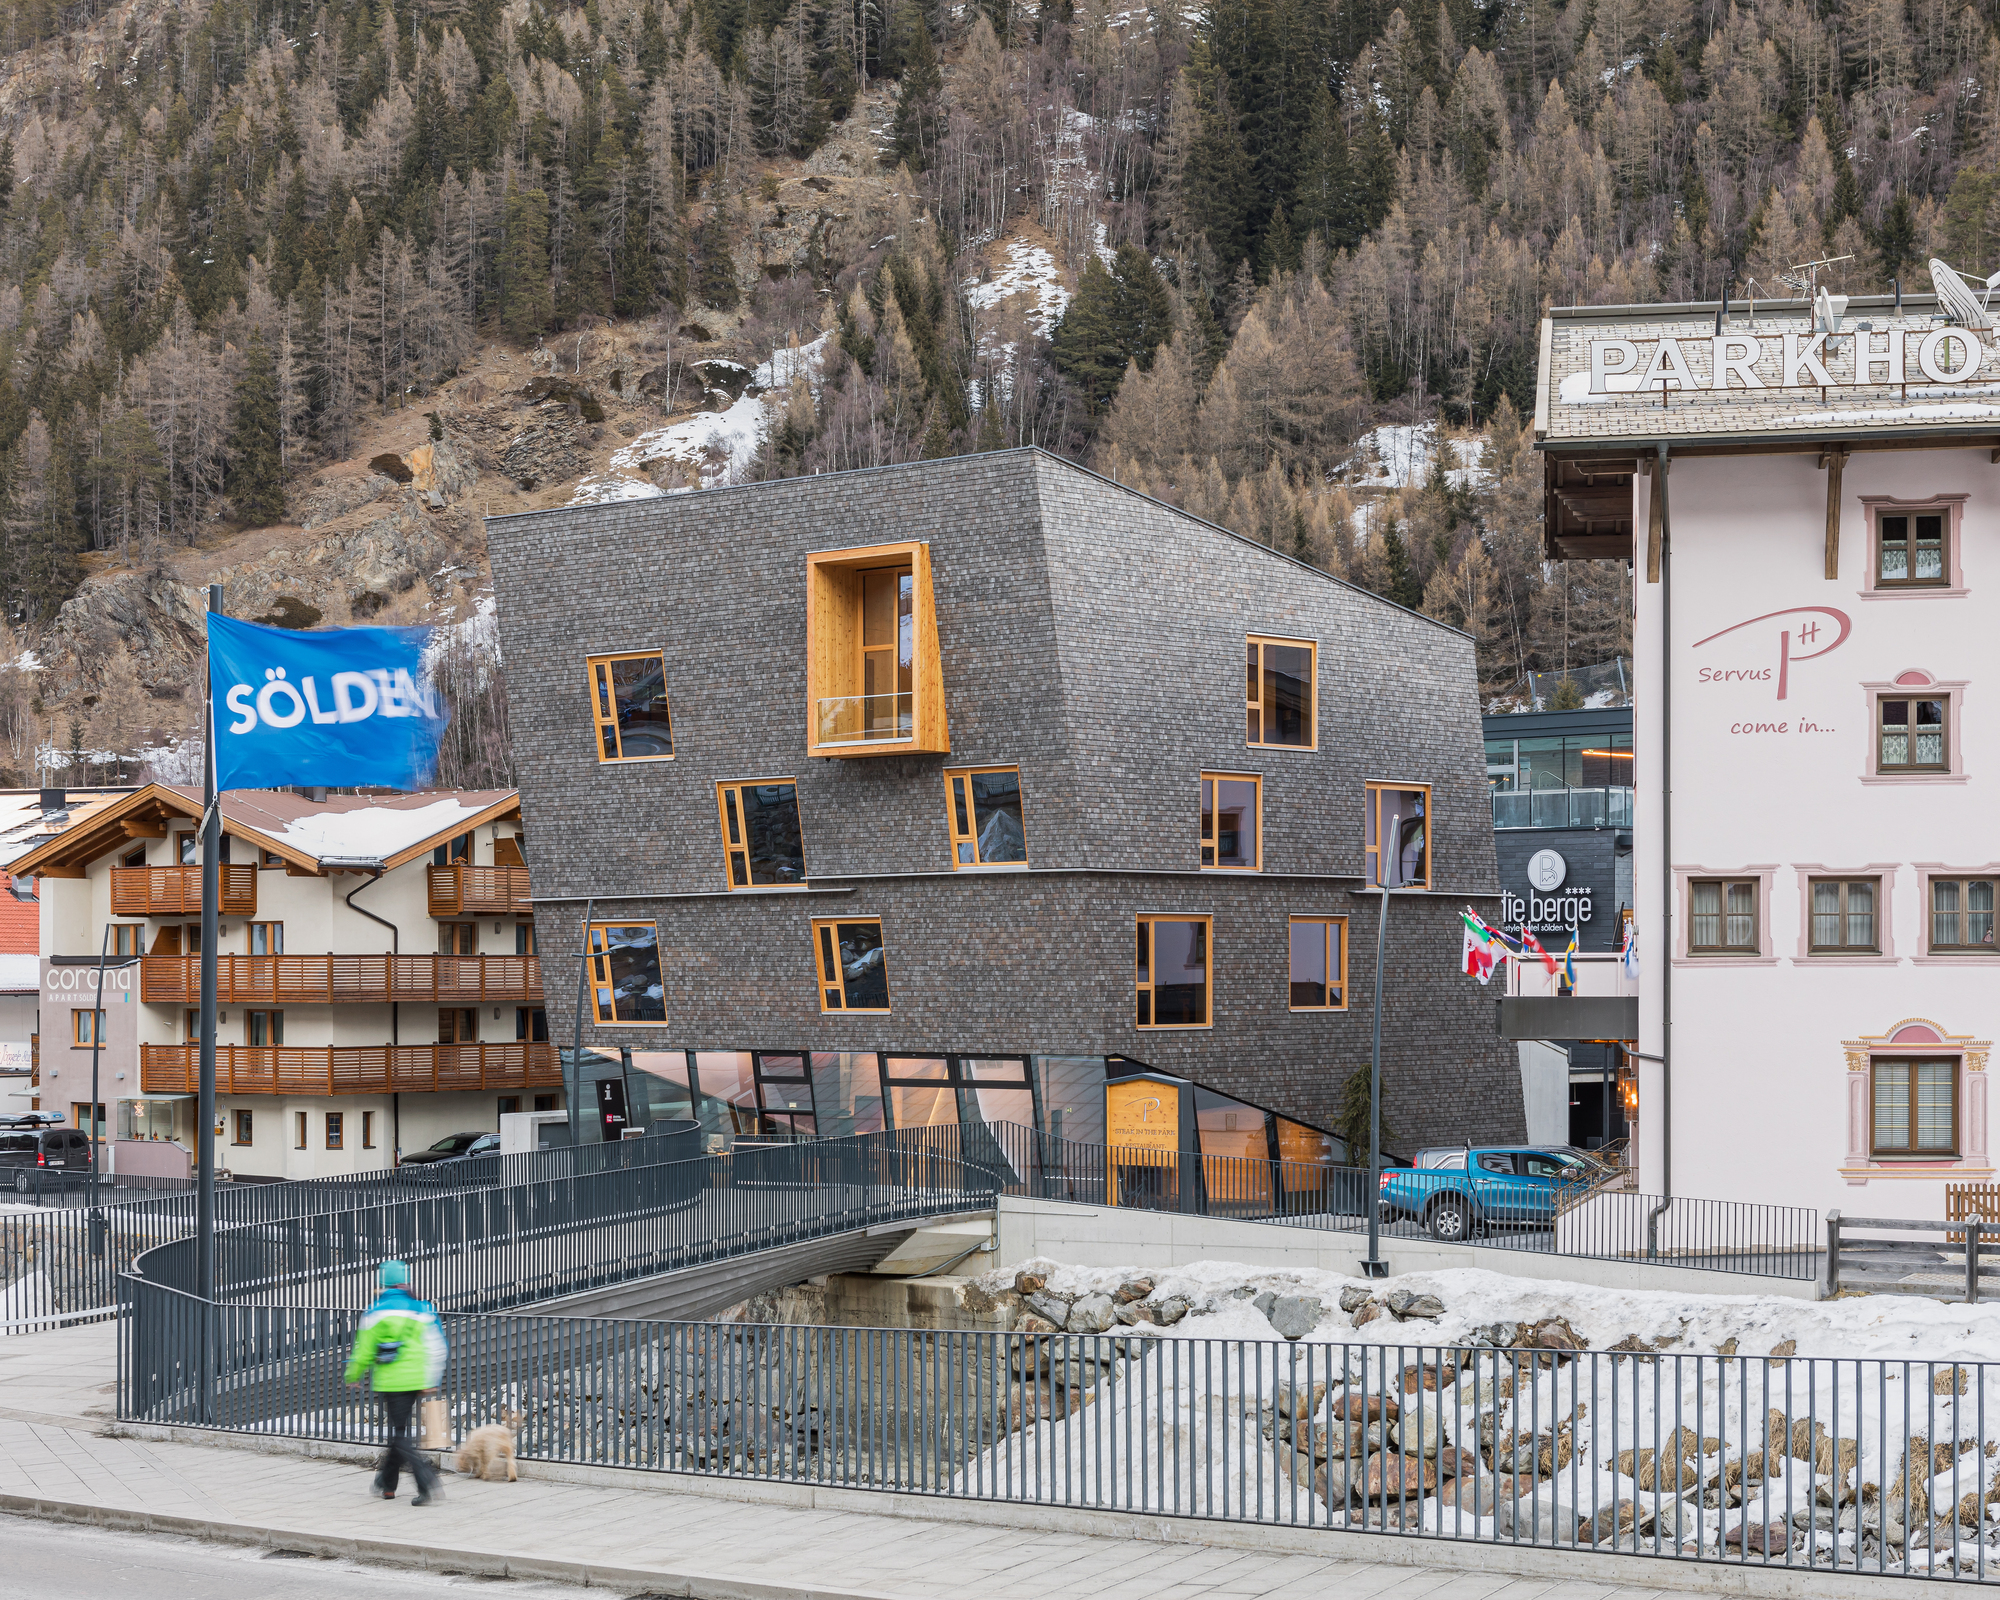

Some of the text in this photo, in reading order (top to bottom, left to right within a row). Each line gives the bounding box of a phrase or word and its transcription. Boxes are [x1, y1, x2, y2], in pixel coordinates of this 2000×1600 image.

[1588, 326, 2000, 394] PARKHO
[1699, 667, 1772, 683] Servus
[226, 666, 440, 735] SÖLDEN
[1730, 717, 1836, 734] come in...
[1530, 889, 1592, 932] berge
[46, 968, 131, 990] corona
[48, 993, 98, 1002] APART SÖLDE
[1144, 1128, 1157, 1136] THE
